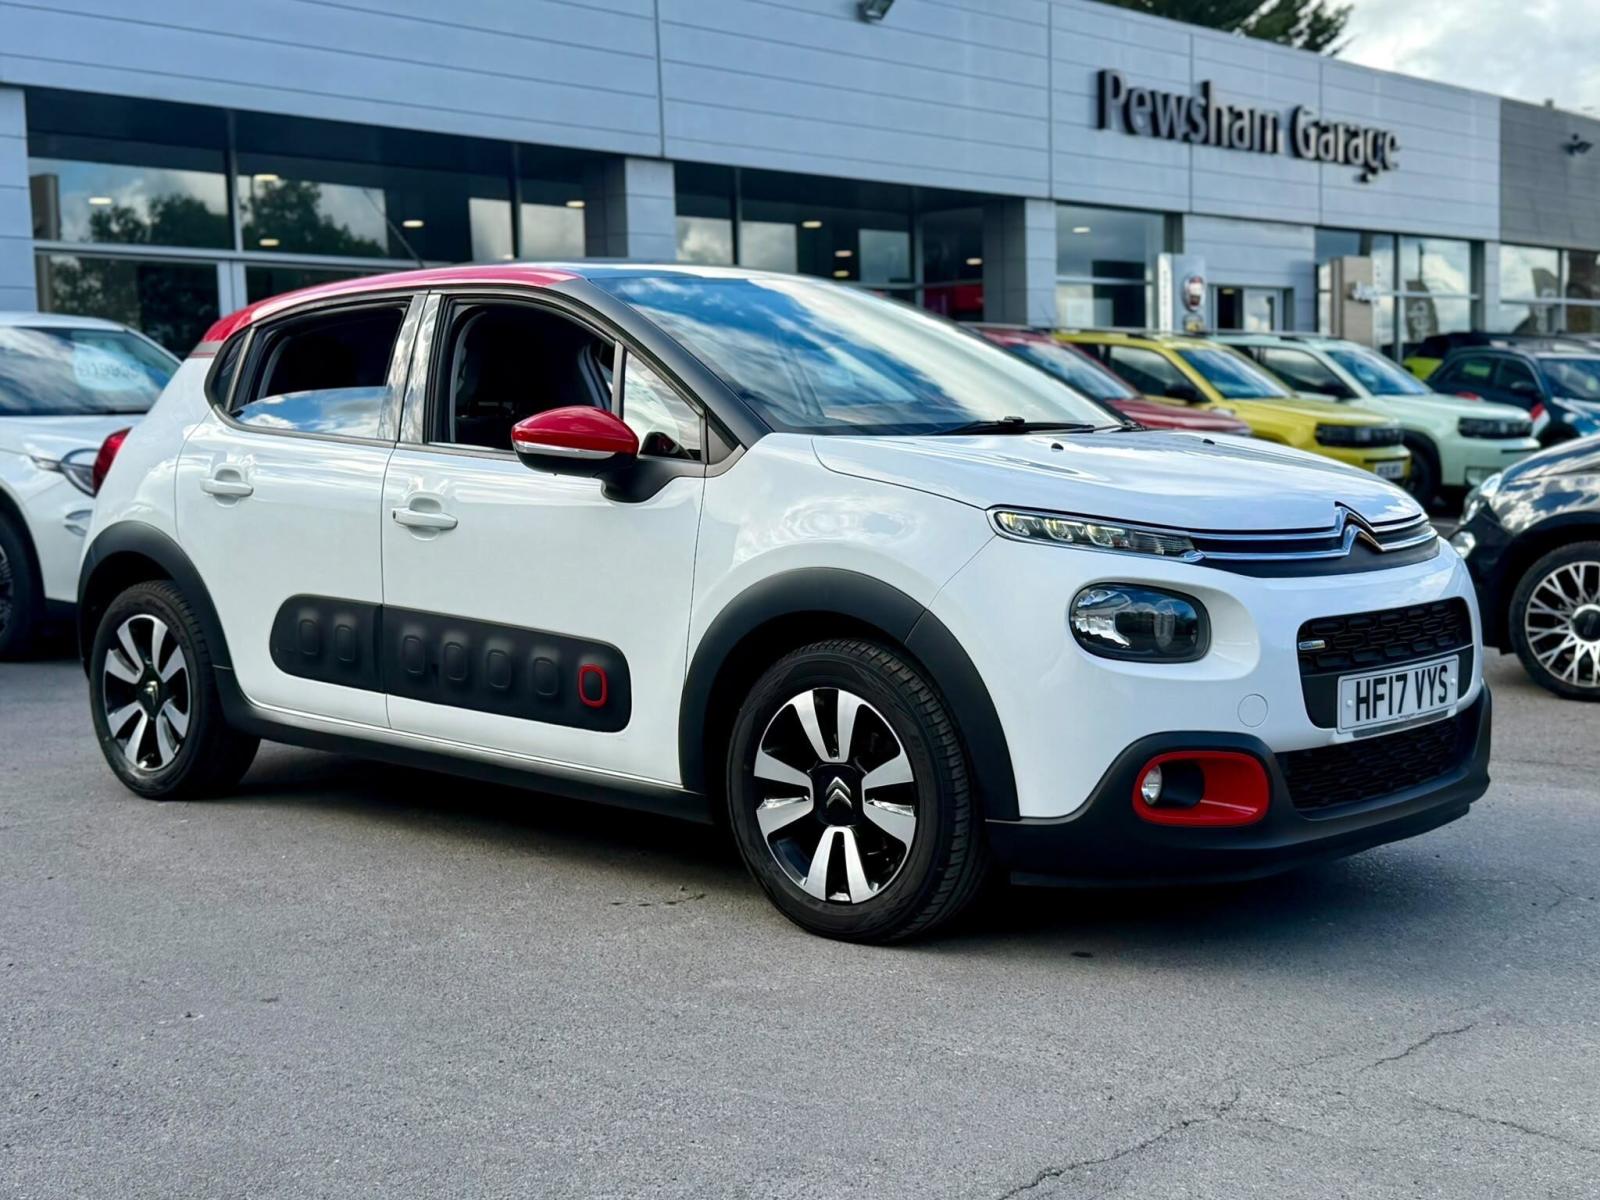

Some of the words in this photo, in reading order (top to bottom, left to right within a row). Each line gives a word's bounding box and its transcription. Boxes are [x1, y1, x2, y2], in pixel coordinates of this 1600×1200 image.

[1096, 69, 1284, 154] Pewsham
[1291, 105, 1398, 183] Garage
[1356, 673, 1408, 721] HF17
[1415, 665, 1448, 709] VYS
